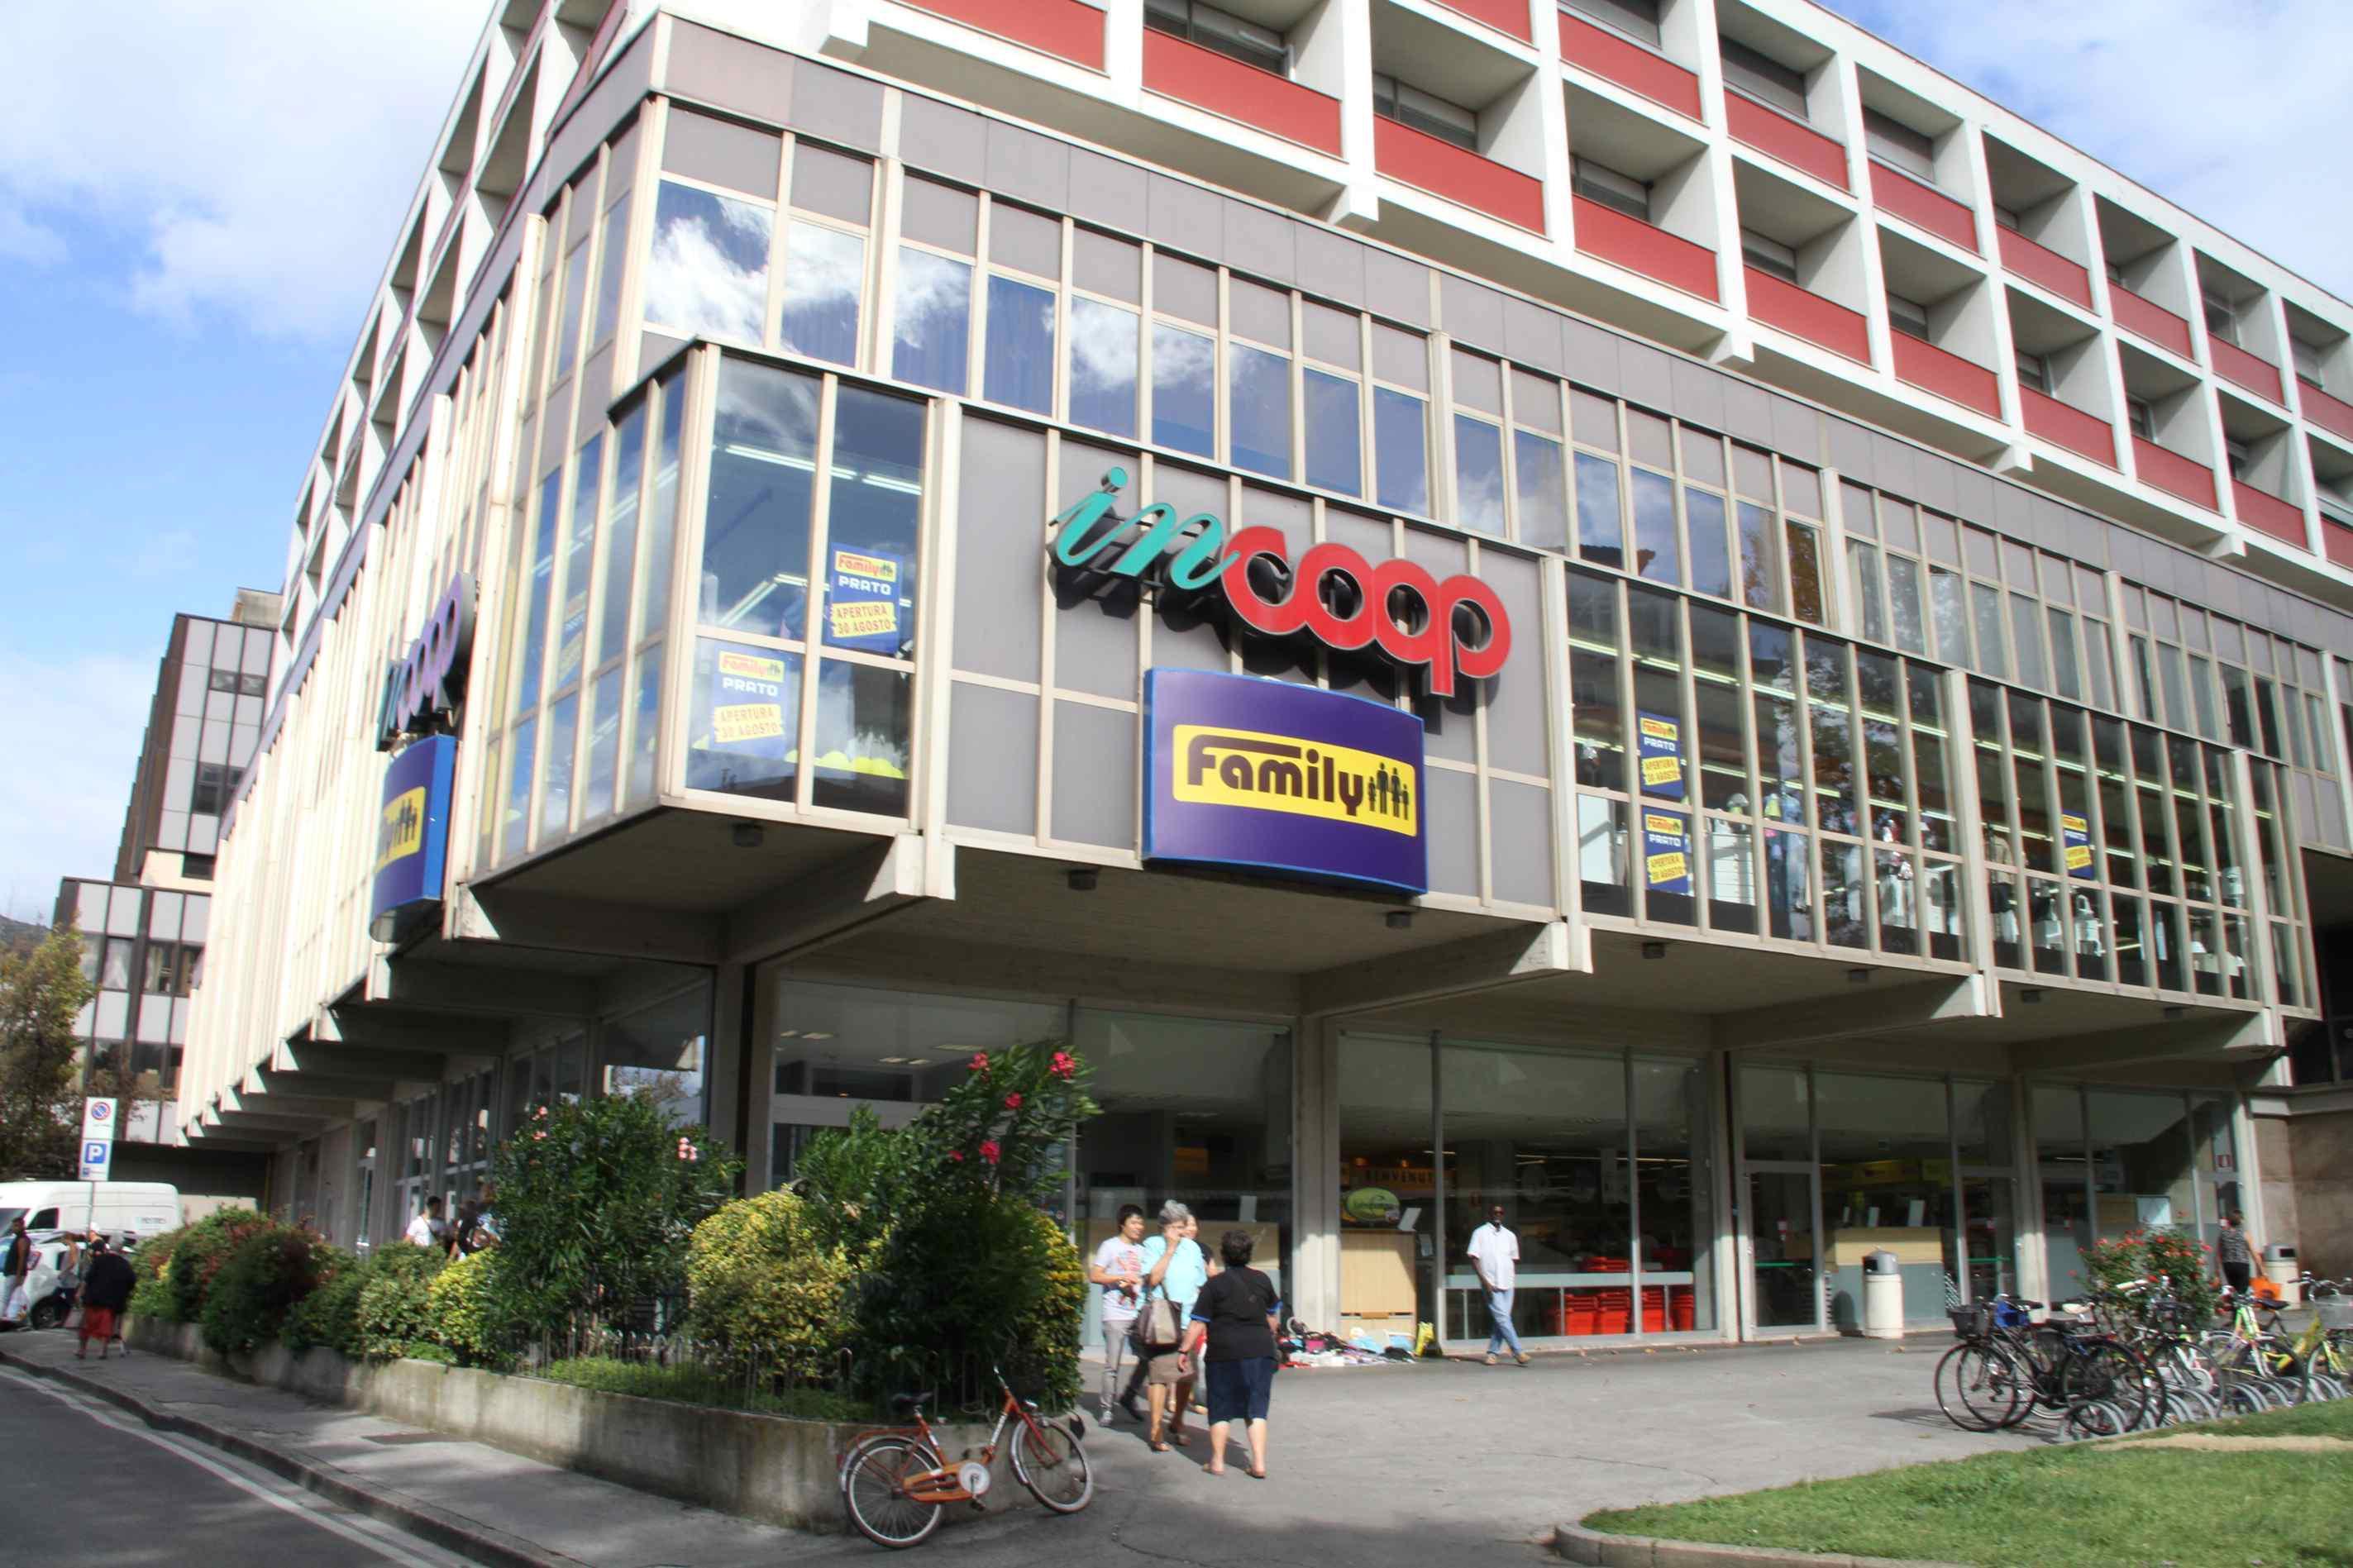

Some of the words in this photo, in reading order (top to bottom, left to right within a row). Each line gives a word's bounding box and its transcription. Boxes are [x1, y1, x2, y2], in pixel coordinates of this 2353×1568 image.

[838, 555, 881, 576] Family
[838, 574, 892, 595] PRATO
[836, 604, 888, 619] APERTURA
[852, 619, 892, 632] AGOSTO
[722, 676, 779, 698] PRATO
[720, 707, 774, 722] APERTURA
[739, 722, 779, 736] AGOSTO
[1186, 732, 1364, 816] Family
[88, 1146, 104, 1161] P
